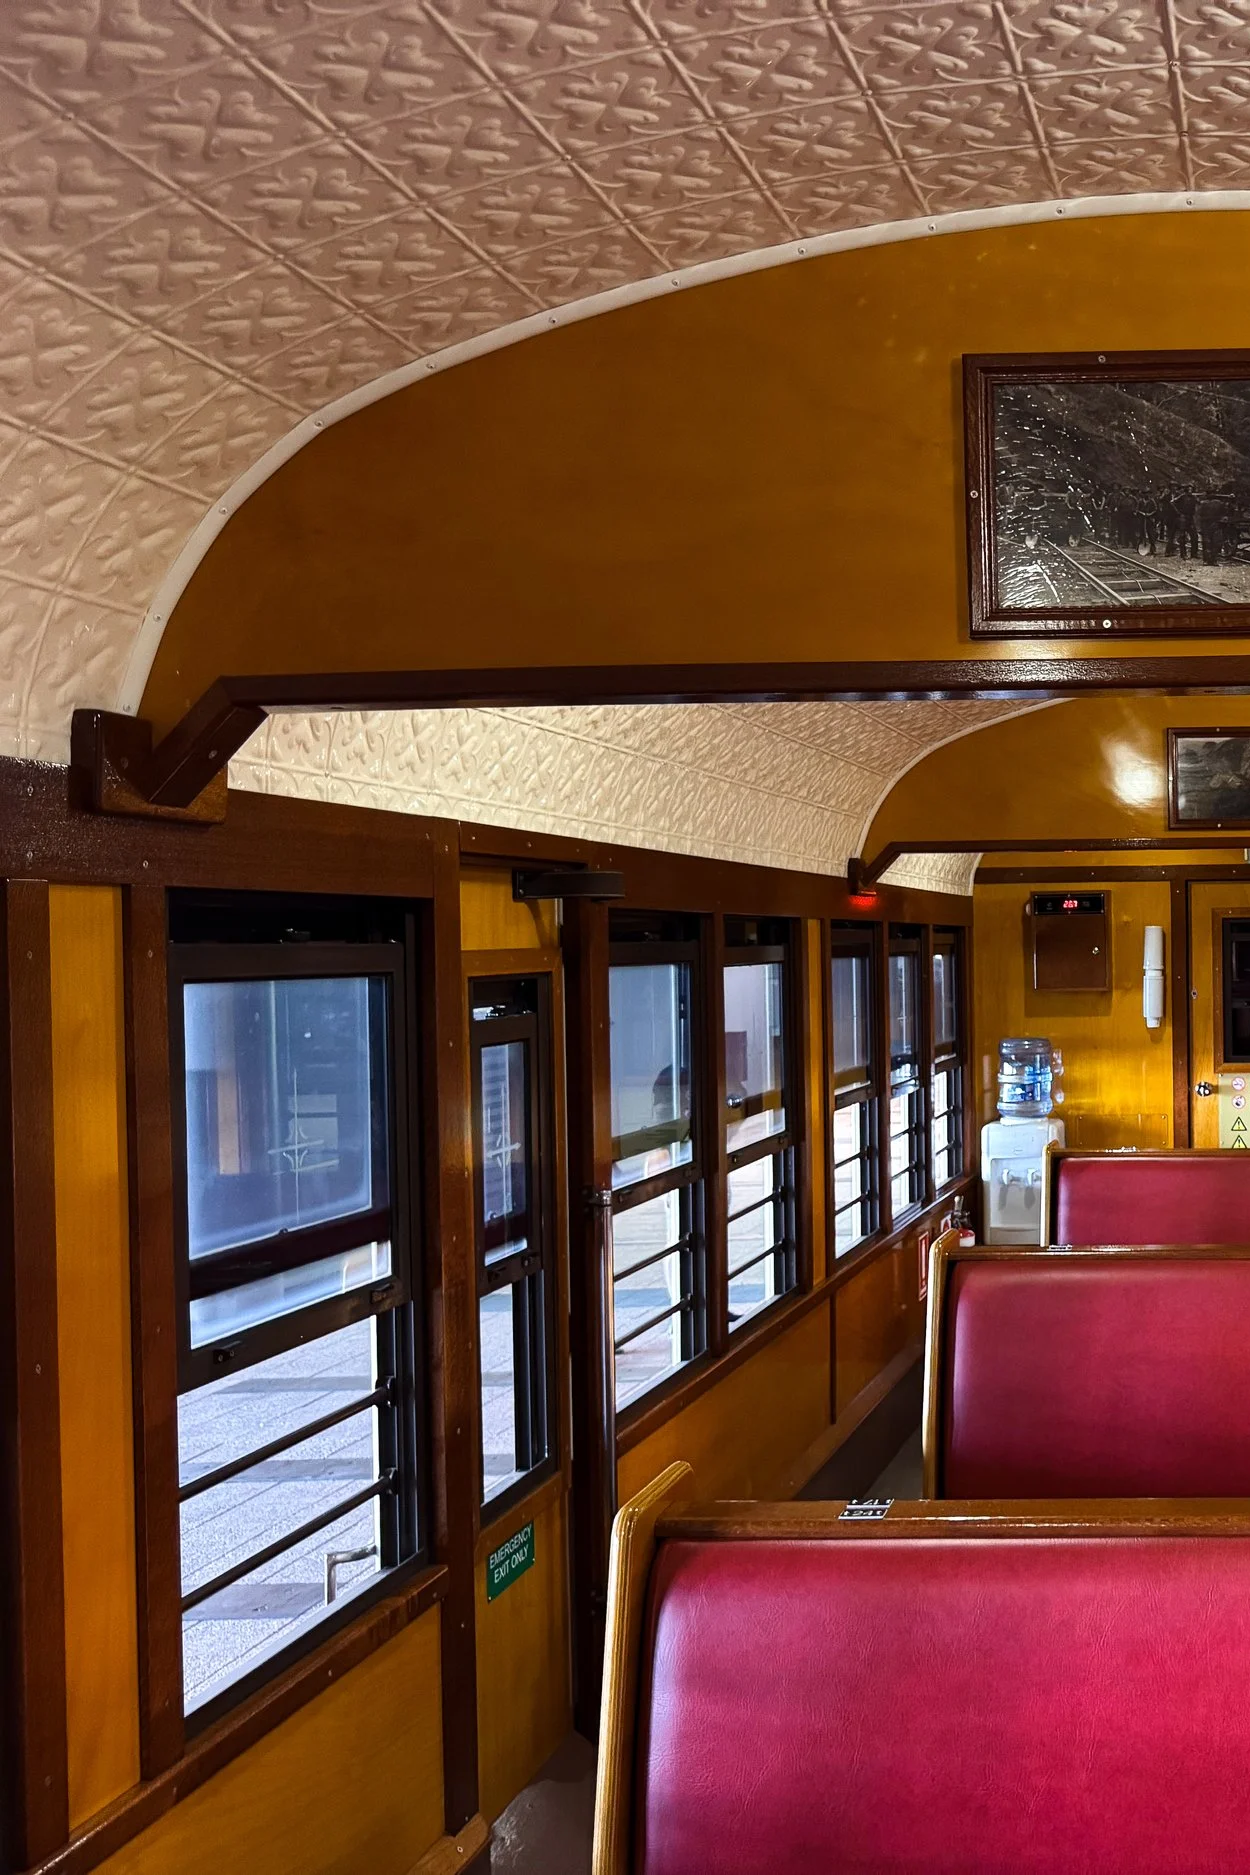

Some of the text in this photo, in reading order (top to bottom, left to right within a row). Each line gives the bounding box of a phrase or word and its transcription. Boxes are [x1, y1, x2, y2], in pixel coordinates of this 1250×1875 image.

[489, 1523, 532, 1570] EMERGENCY
[494, 1544, 529, 1584] EXIT ONLY
